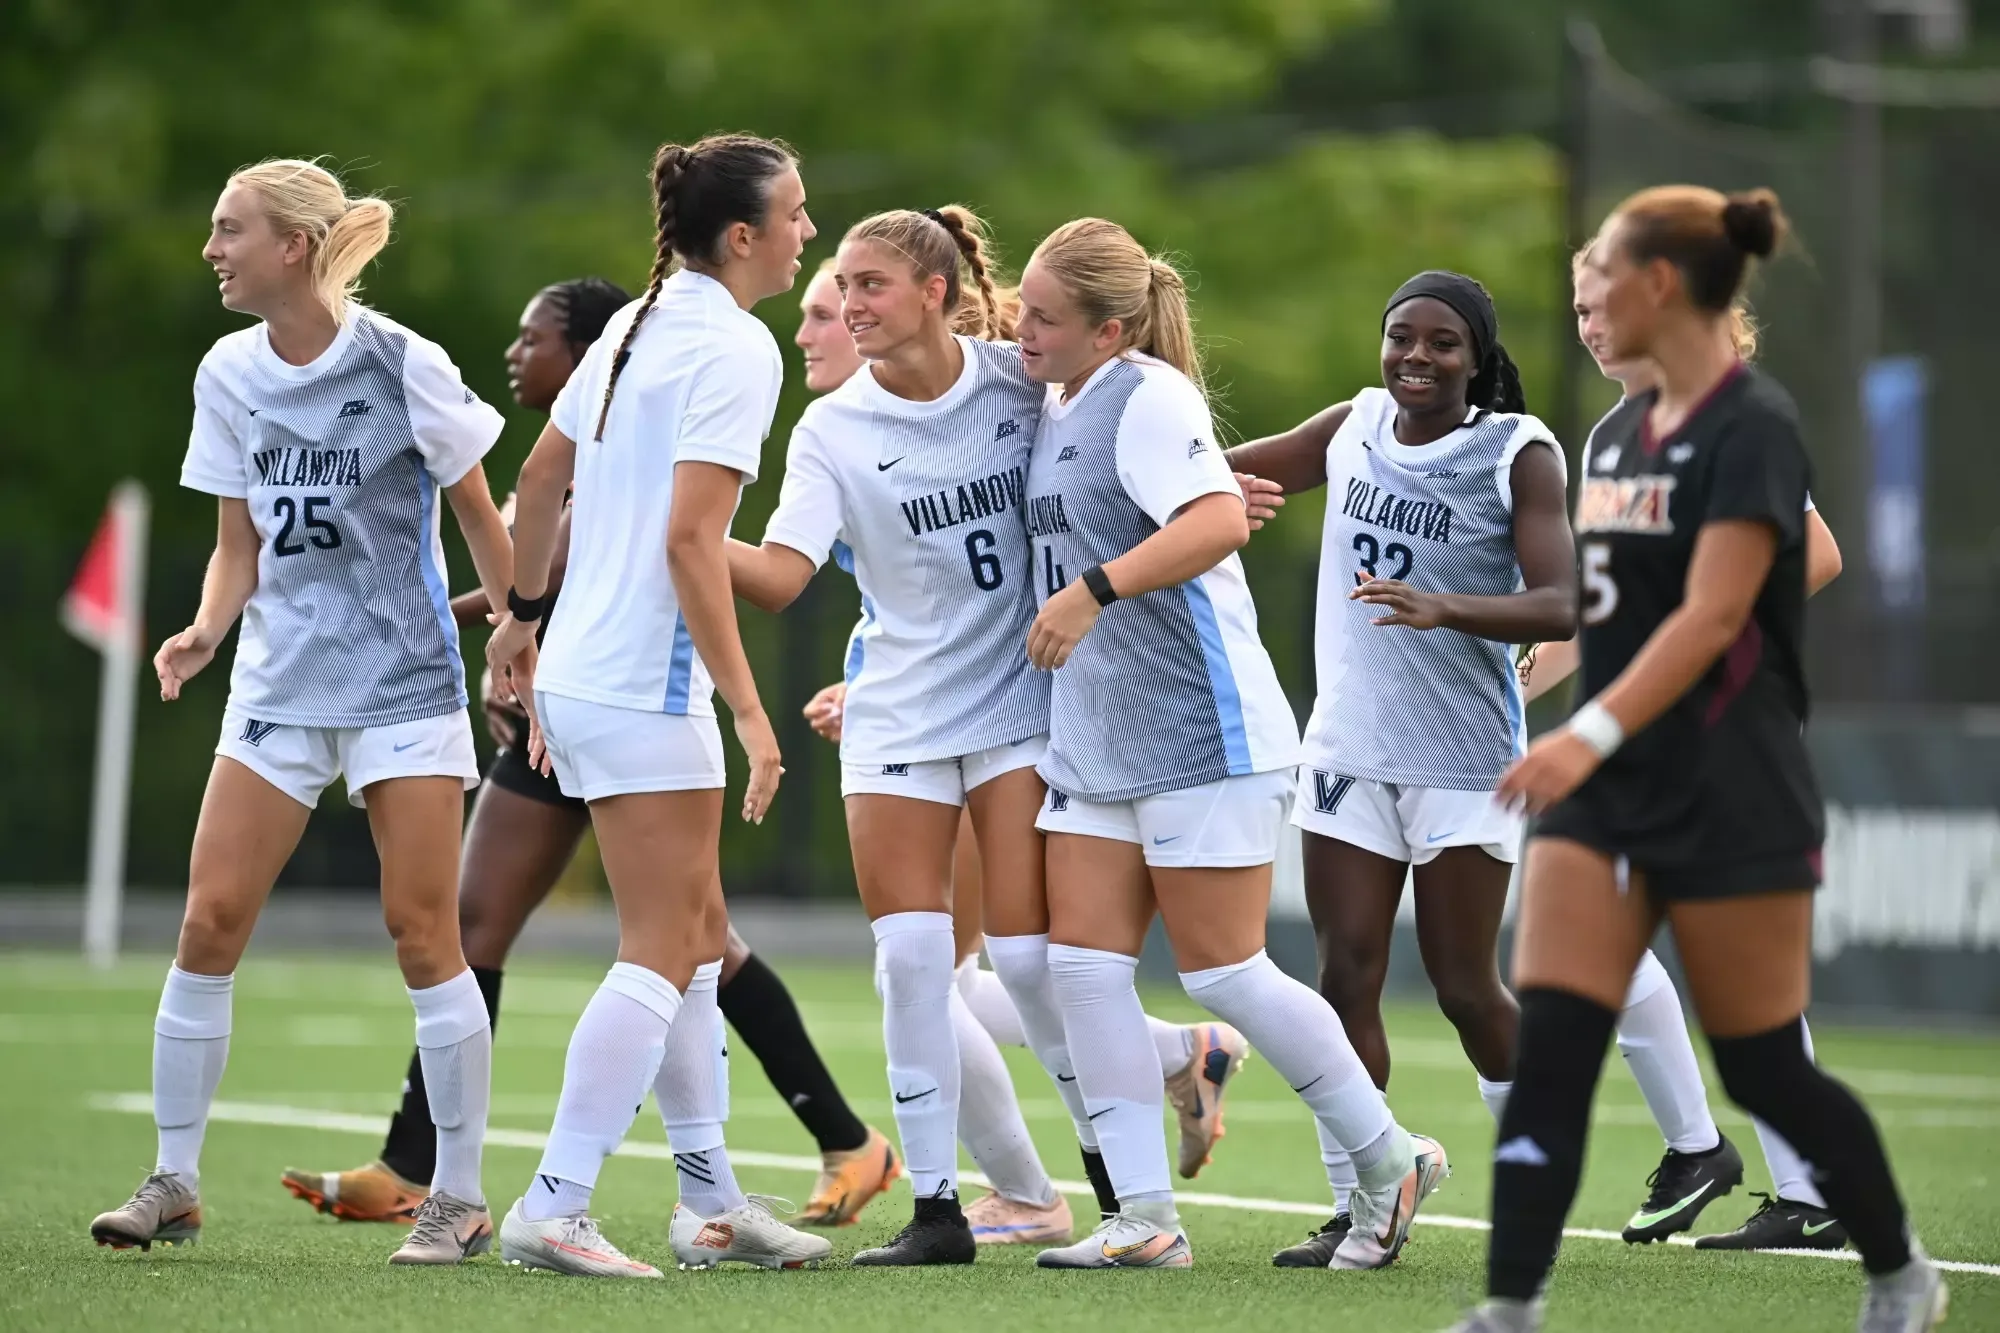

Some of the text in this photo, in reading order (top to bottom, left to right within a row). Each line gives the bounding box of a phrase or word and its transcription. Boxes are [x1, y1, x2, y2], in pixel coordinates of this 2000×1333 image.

[253, 448, 360, 486] VILLANOVA
[274, 496, 342, 557] 25
[1025, 494, 1072, 539] LANOVA
[1342, 476, 1452, 543] VILLANOVA
[965, 529, 1003, 591] 6
[1353, 532, 1413, 587] 32
[1313, 769, 1355, 815] V
